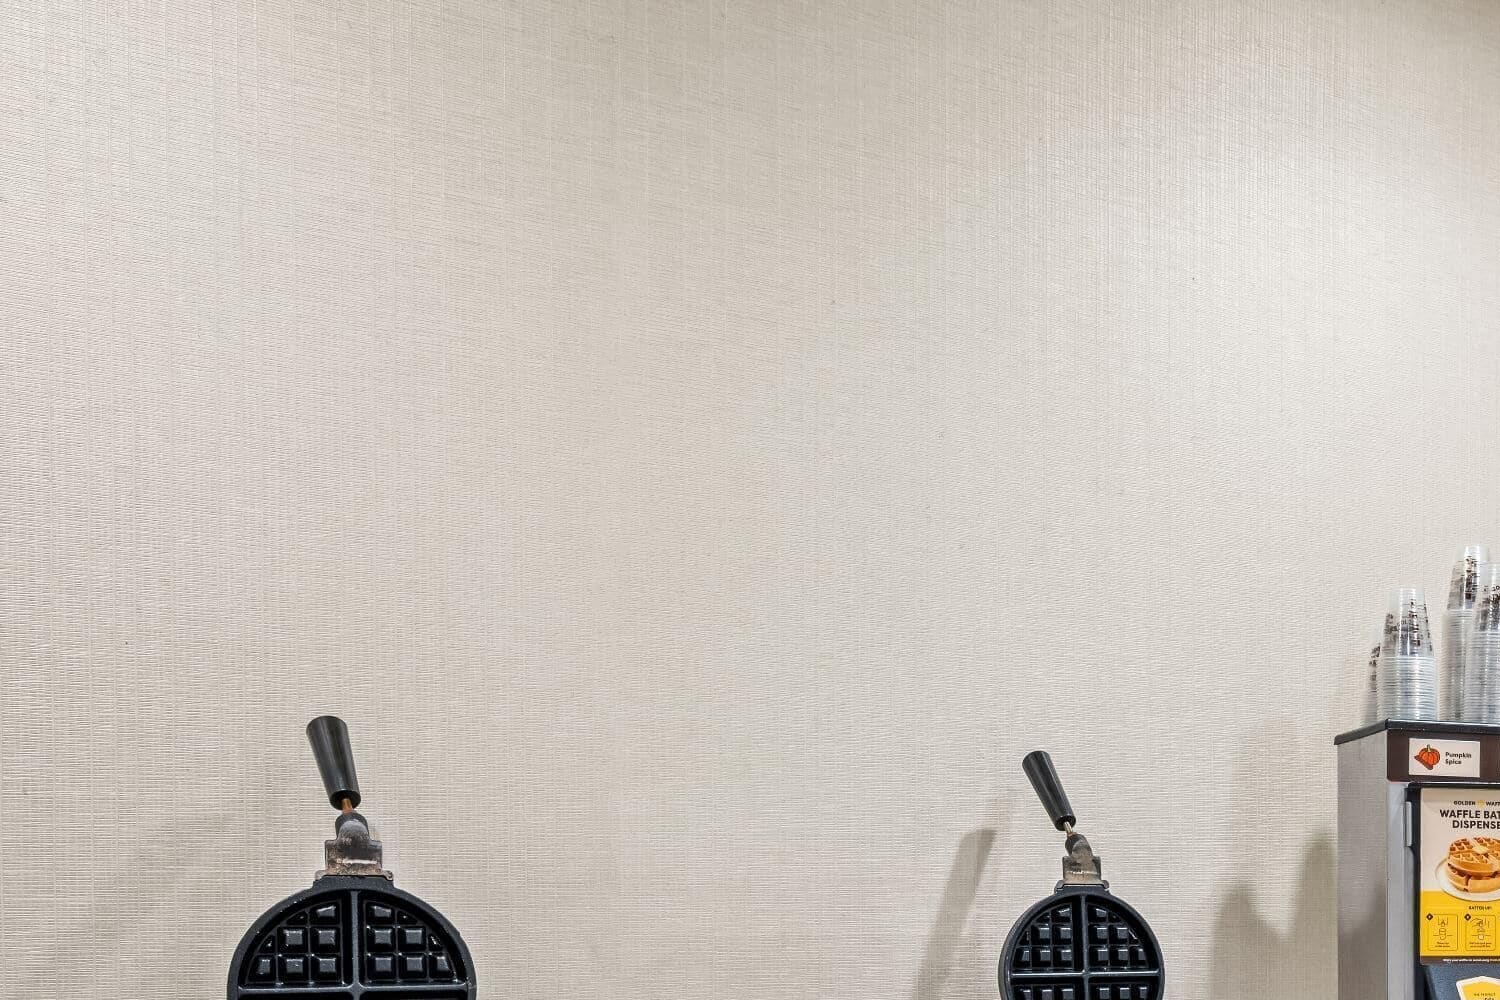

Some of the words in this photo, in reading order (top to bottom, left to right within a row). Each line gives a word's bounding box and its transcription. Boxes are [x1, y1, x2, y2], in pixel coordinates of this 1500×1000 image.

[1445, 751, 1472, 760] Pumpkin
[1445, 758, 1462, 766] Spice
[1440, 809, 1481, 819] WAFFLE
